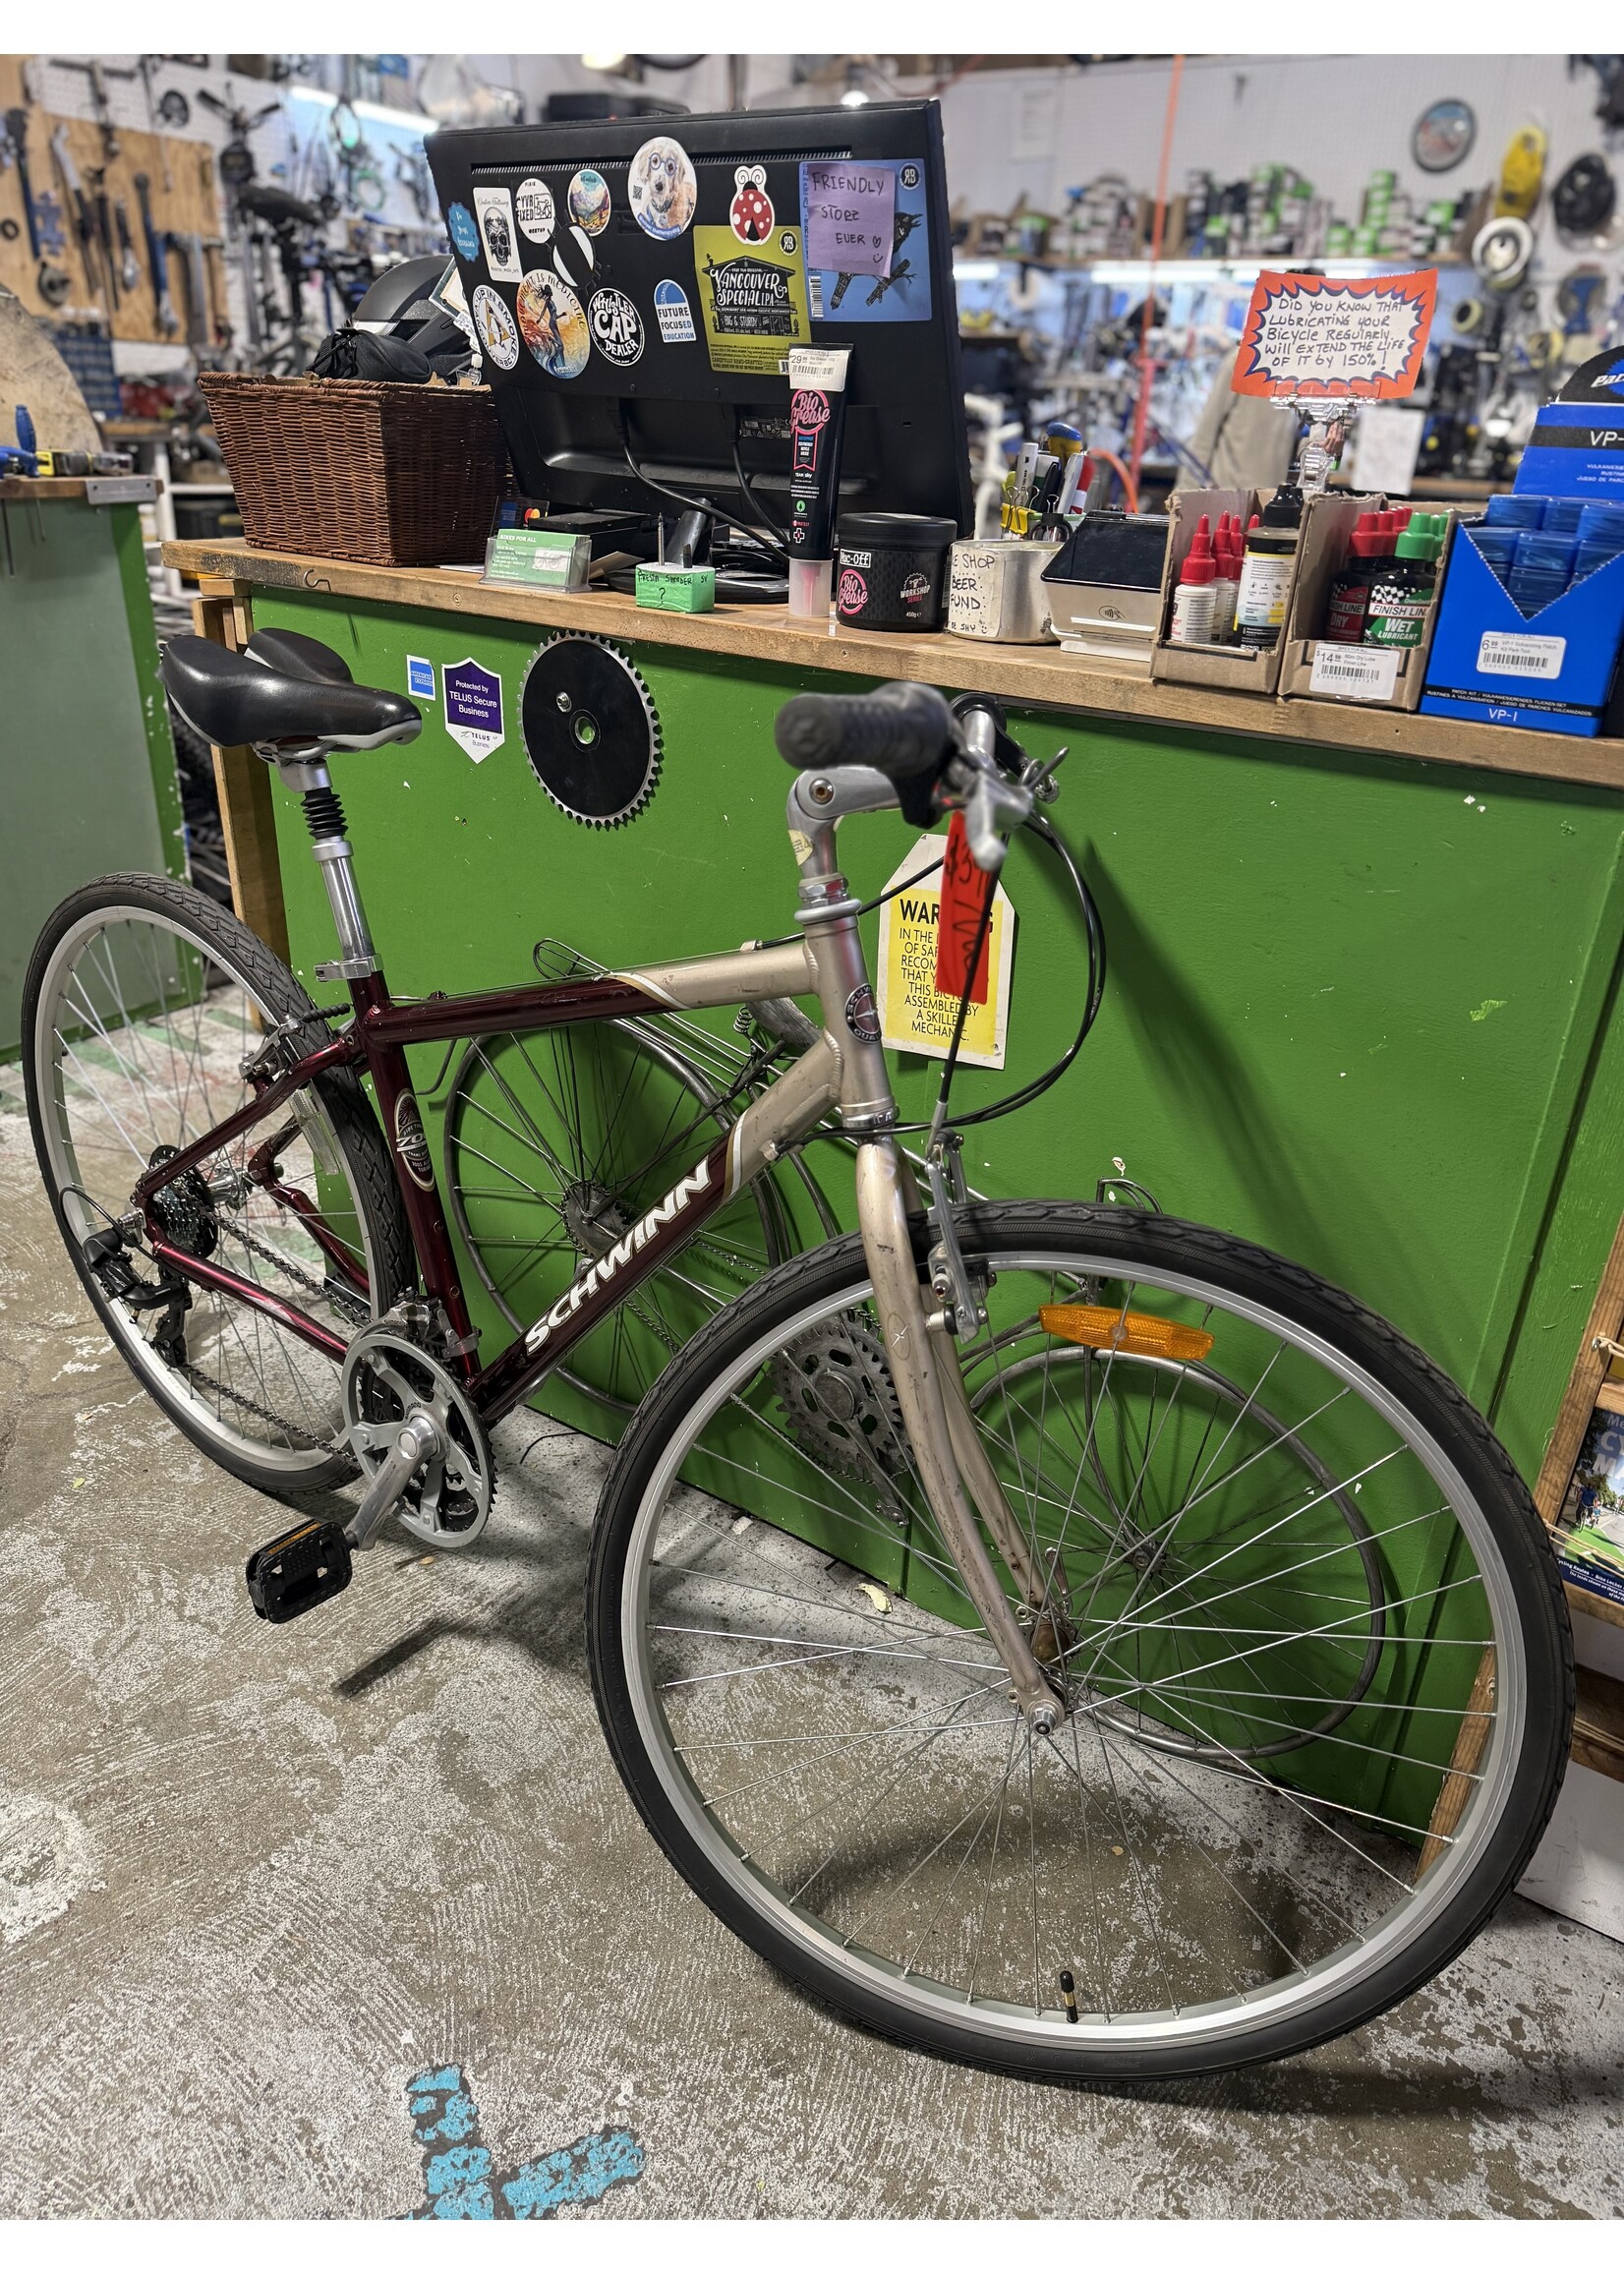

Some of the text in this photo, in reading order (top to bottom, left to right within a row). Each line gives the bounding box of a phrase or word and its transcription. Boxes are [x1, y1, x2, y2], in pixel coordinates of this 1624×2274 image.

[813, 172, 884, 196] FRIENDLY
[516, 208, 534, 221] FIXED
[710, 262, 787, 299] VANCOUVER
[476, 290, 486, 301] UP
[717, 289, 760, 306] SPECIAL
[593, 292, 636, 323] WHISTLER
[658, 307, 689, 318] FUTURE
[1336, 300, 1371, 312] KNOW
[594, 310, 637, 342] CAP
[661, 321, 692, 330] FOCUSED
[605, 339, 639, 357] DEALER
[1351, 341, 1373, 351] THE
[1272, 356, 1291, 367] OF
[1298, 355, 1310, 366] IT
[962, 554, 995, 569] SHOP
[953, 575, 978, 591] BEER
[659, 587, 666, 604] ?
[900, 585, 930, 598] WORKSHOP
[951, 594, 981, 610] FUND
[1345, 604, 1363, 613] LINE
[1373, 605, 1425, 616] FINISH LIN
[960, 623, 976, 632] SHY
[1331, 613, 1349, 628] DRY
[1384, 618, 1415, 632] WET
[1377, 631, 1418, 640] LUBRICANT
[410, 671, 432, 680] AMERICAN
[415, 677, 434, 686] EXPRESS
[455, 679, 489, 693] Protected by
[449, 690, 497, 708] TELUS Secure
[1457, 694, 1495, 704] VULCANISATION
[458, 704, 489, 718] Business
[472, 731, 491, 740] TELUS
[899, 927, 911, 940] IN
[914, 930, 933, 944] THE
[904, 942, 918, 954] OF
[901, 968, 928, 981] THAT
[908, 982, 931, 996] THIS
[904, 997, 979, 1017] ASSEMBLED BY
[916, 1009, 957, 1026] A SKILLE
[912, 1020, 969, 1041] MECHANC.
[525, 1154, 712, 1355] SCHWINN
[1574, 1565, 1590, 1575] Routes
